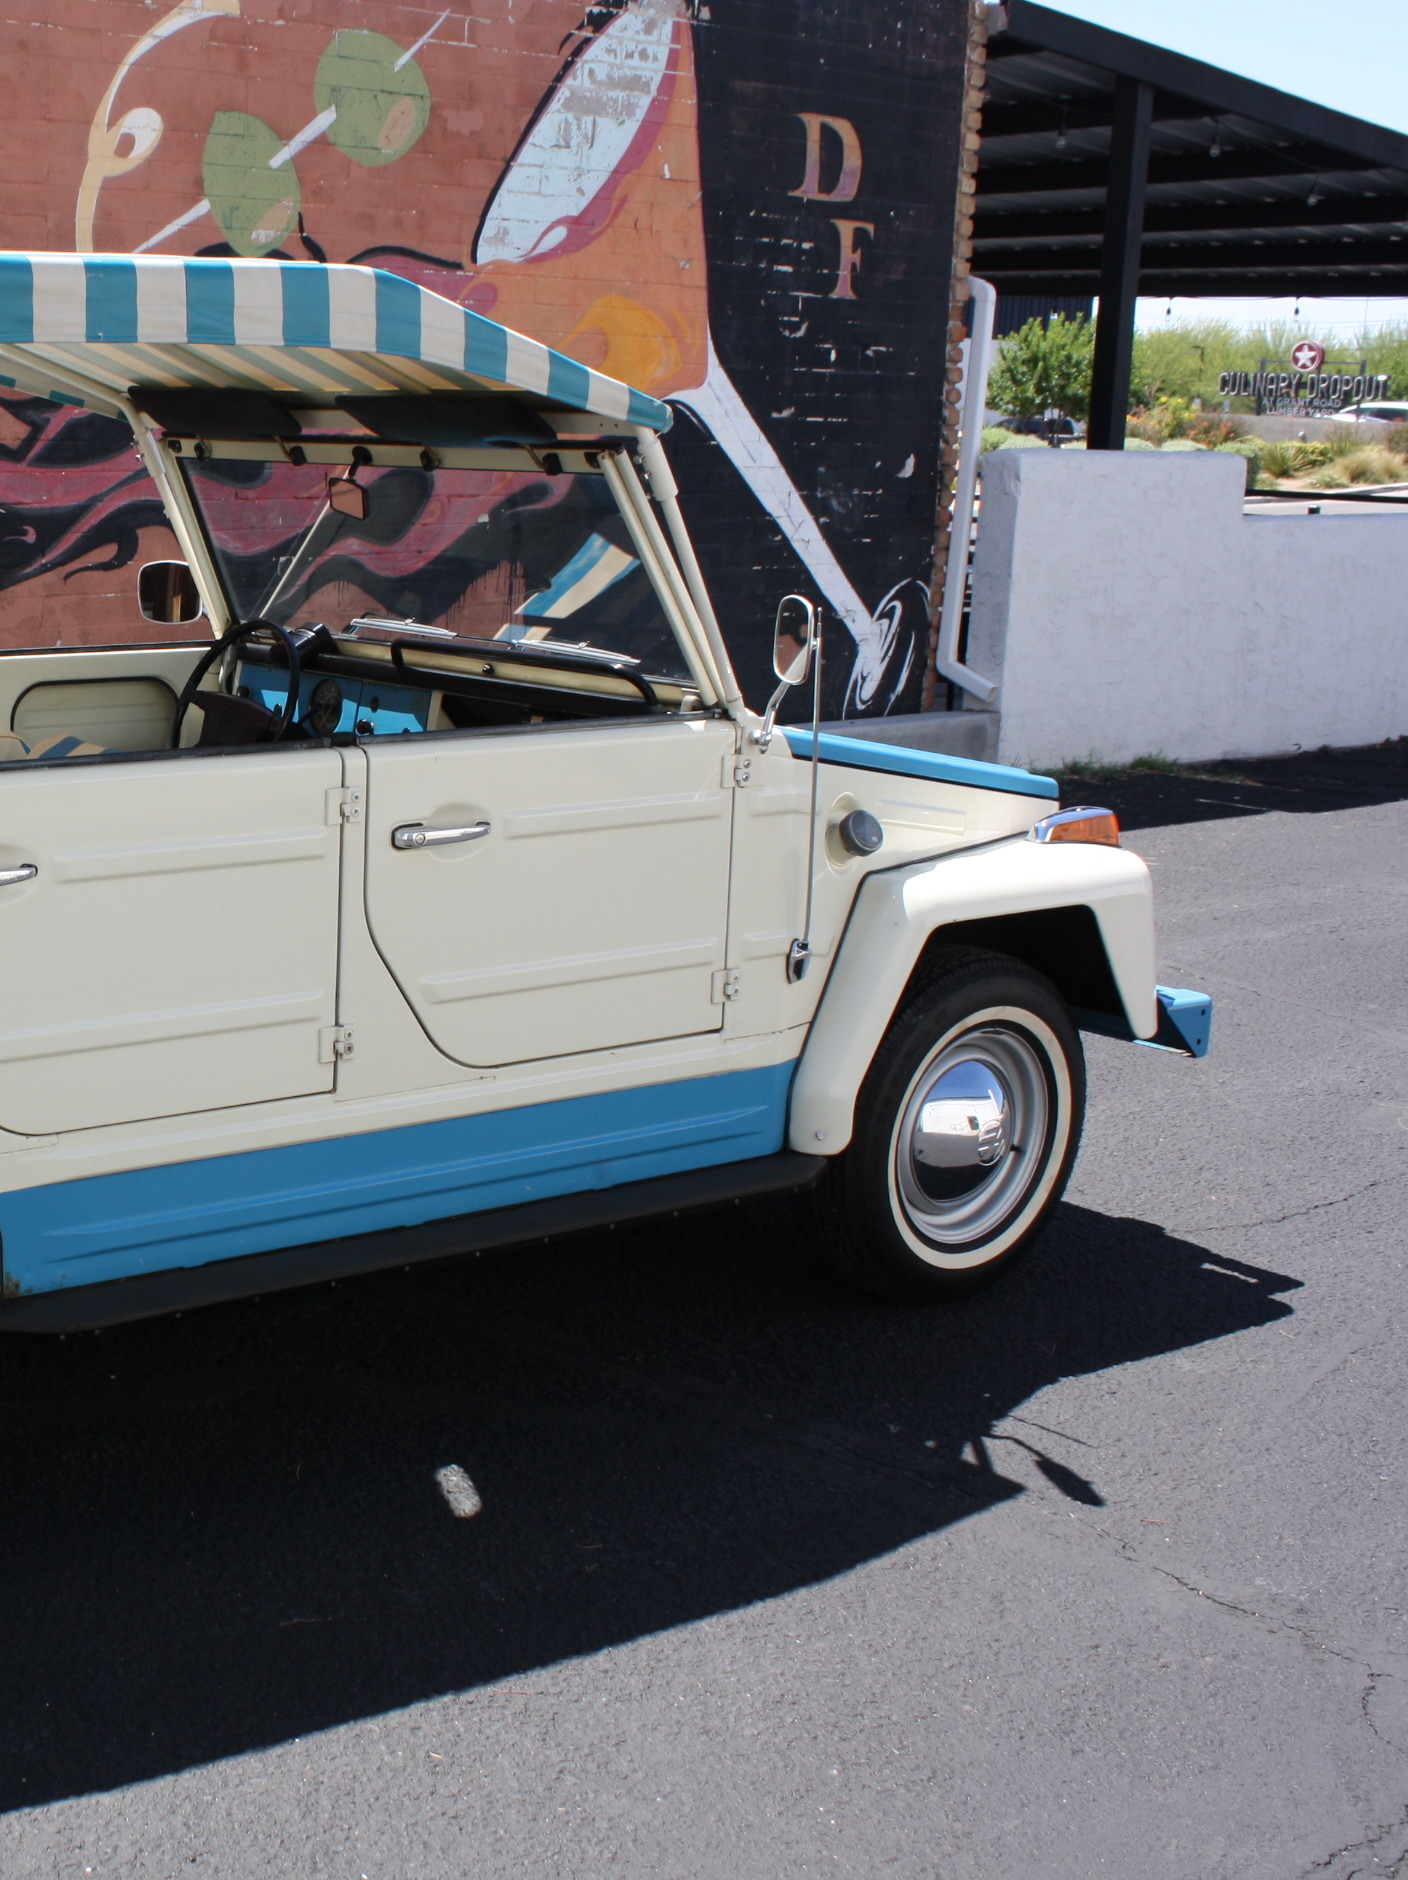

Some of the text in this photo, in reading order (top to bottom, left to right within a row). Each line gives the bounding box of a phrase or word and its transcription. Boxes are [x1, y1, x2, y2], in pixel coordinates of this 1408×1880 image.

[787, 112, 863, 202] D
[828, 218, 875, 299] F
[1219, 372, 1390, 400] CULINARY DROPOUT
[1266, 407, 1306, 416] LUMBER
[1312, 399, 1342, 408] ROAD
